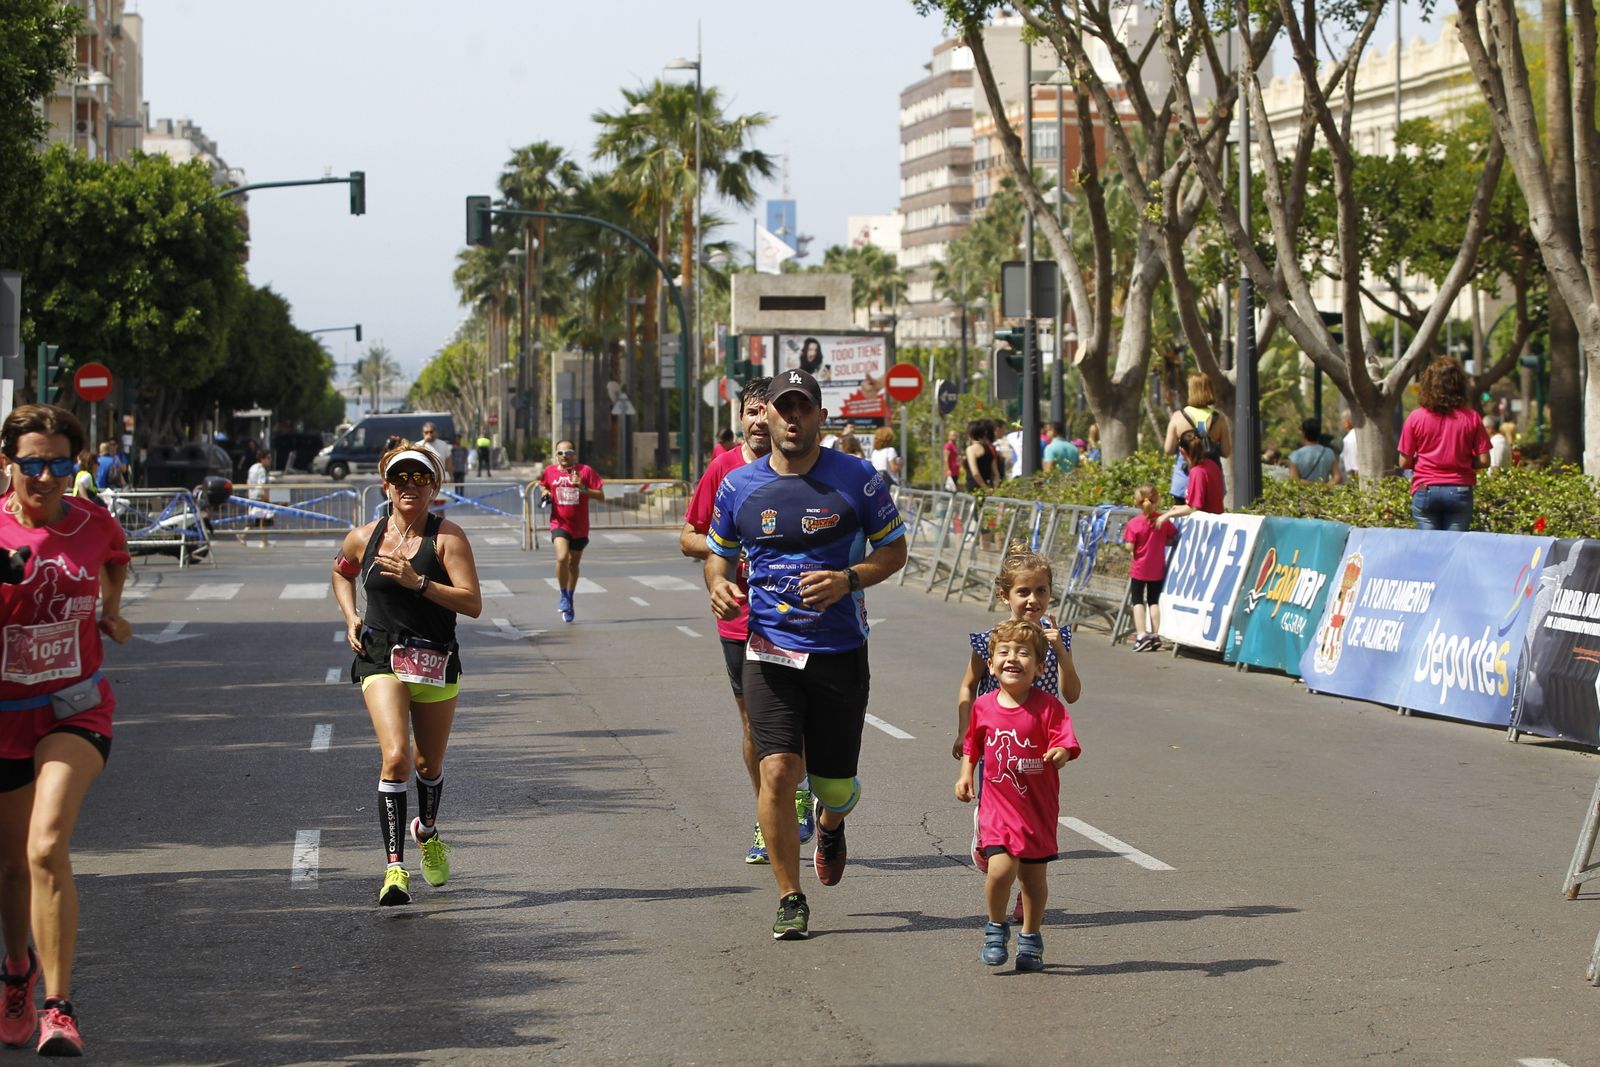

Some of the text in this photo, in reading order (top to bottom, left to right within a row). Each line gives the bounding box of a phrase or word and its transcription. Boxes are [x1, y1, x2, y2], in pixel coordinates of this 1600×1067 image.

[830, 344, 882, 362] TODO TIENE
[789, 371, 802, 384] LA
[1265, 549, 1327, 618] cajamar
[1347, 616, 1365, 647] DE
[28, 637, 73, 661] 1067
[1414, 618, 1510, 704] deportes
